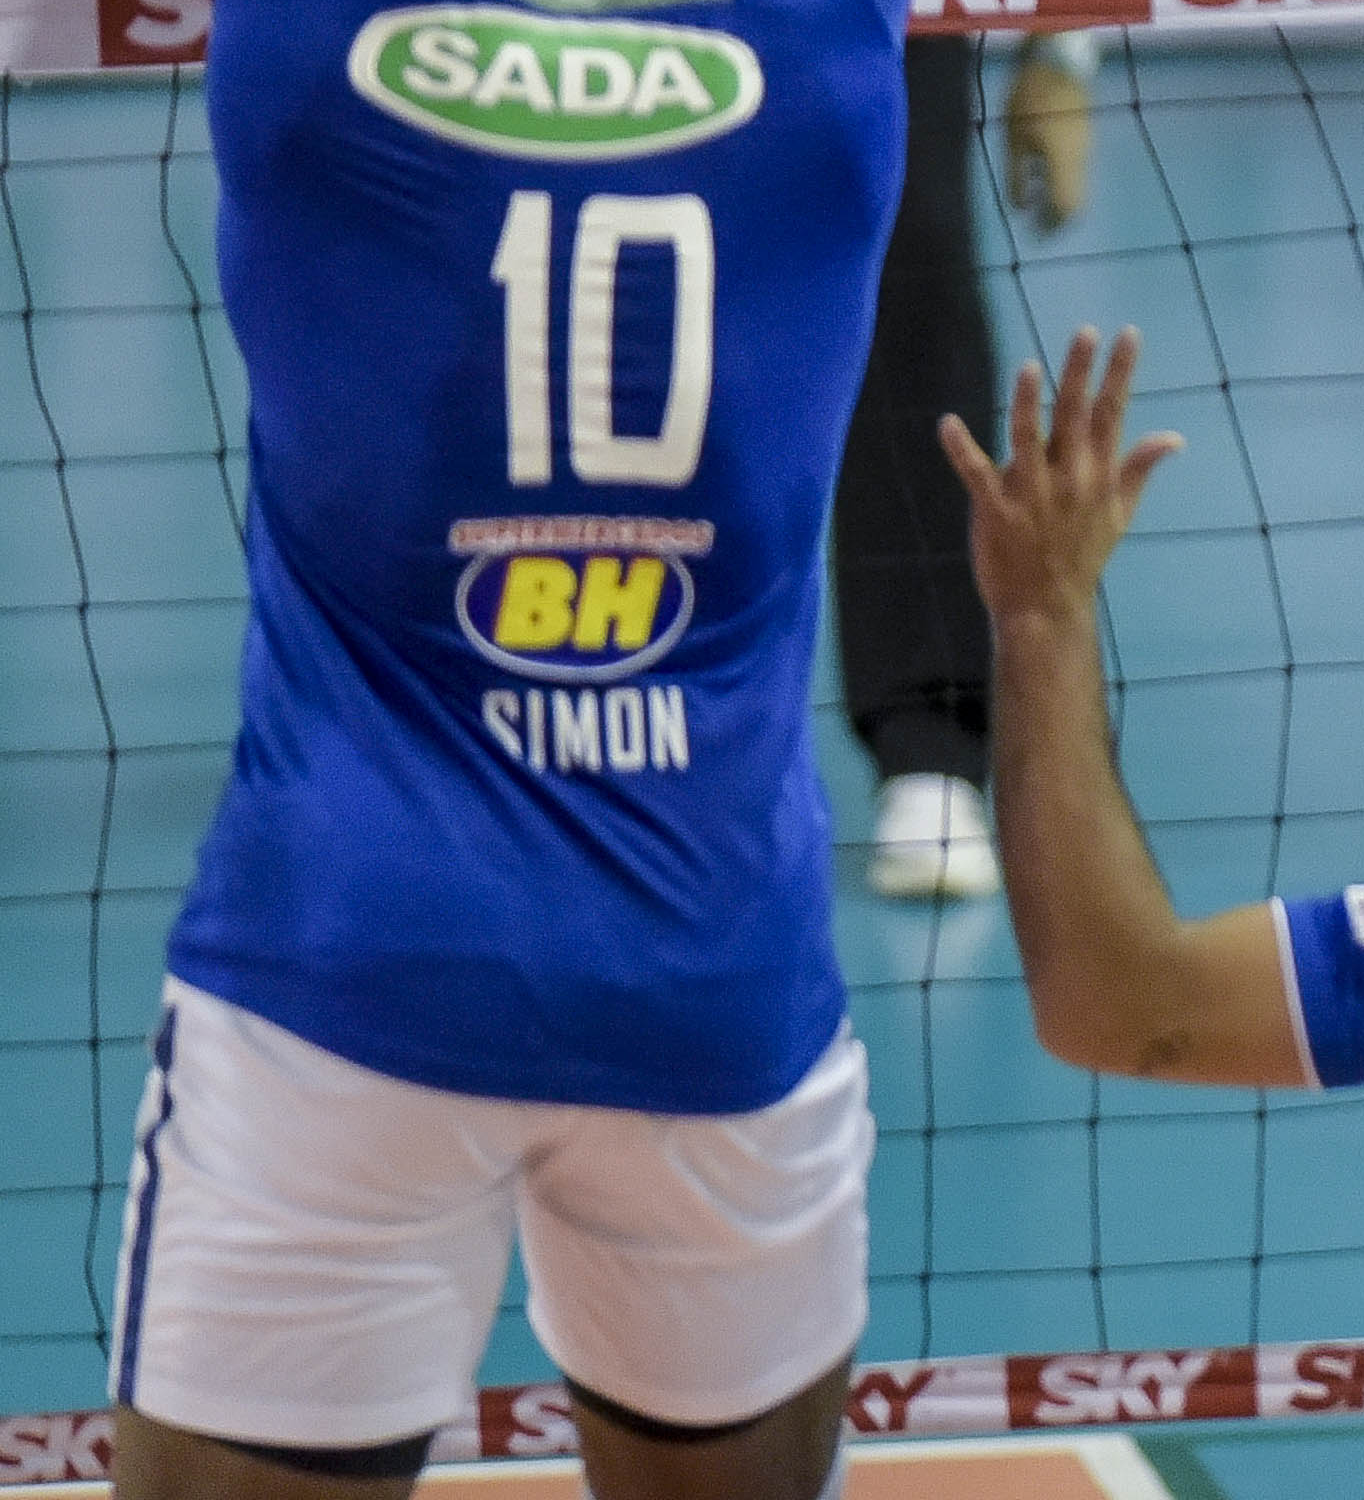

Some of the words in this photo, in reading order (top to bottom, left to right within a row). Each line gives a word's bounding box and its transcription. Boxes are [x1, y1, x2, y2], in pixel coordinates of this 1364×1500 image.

[401, 24, 717, 118] SADA
[489, 189, 715, 487] 10
[494, 556, 665, 651] BH
[481, 685, 691, 773] SIMON
[845, 1367, 935, 1426] KY
[1033, 1351, 1212, 1423] SKY
[0, 1415, 115, 1485] SK
